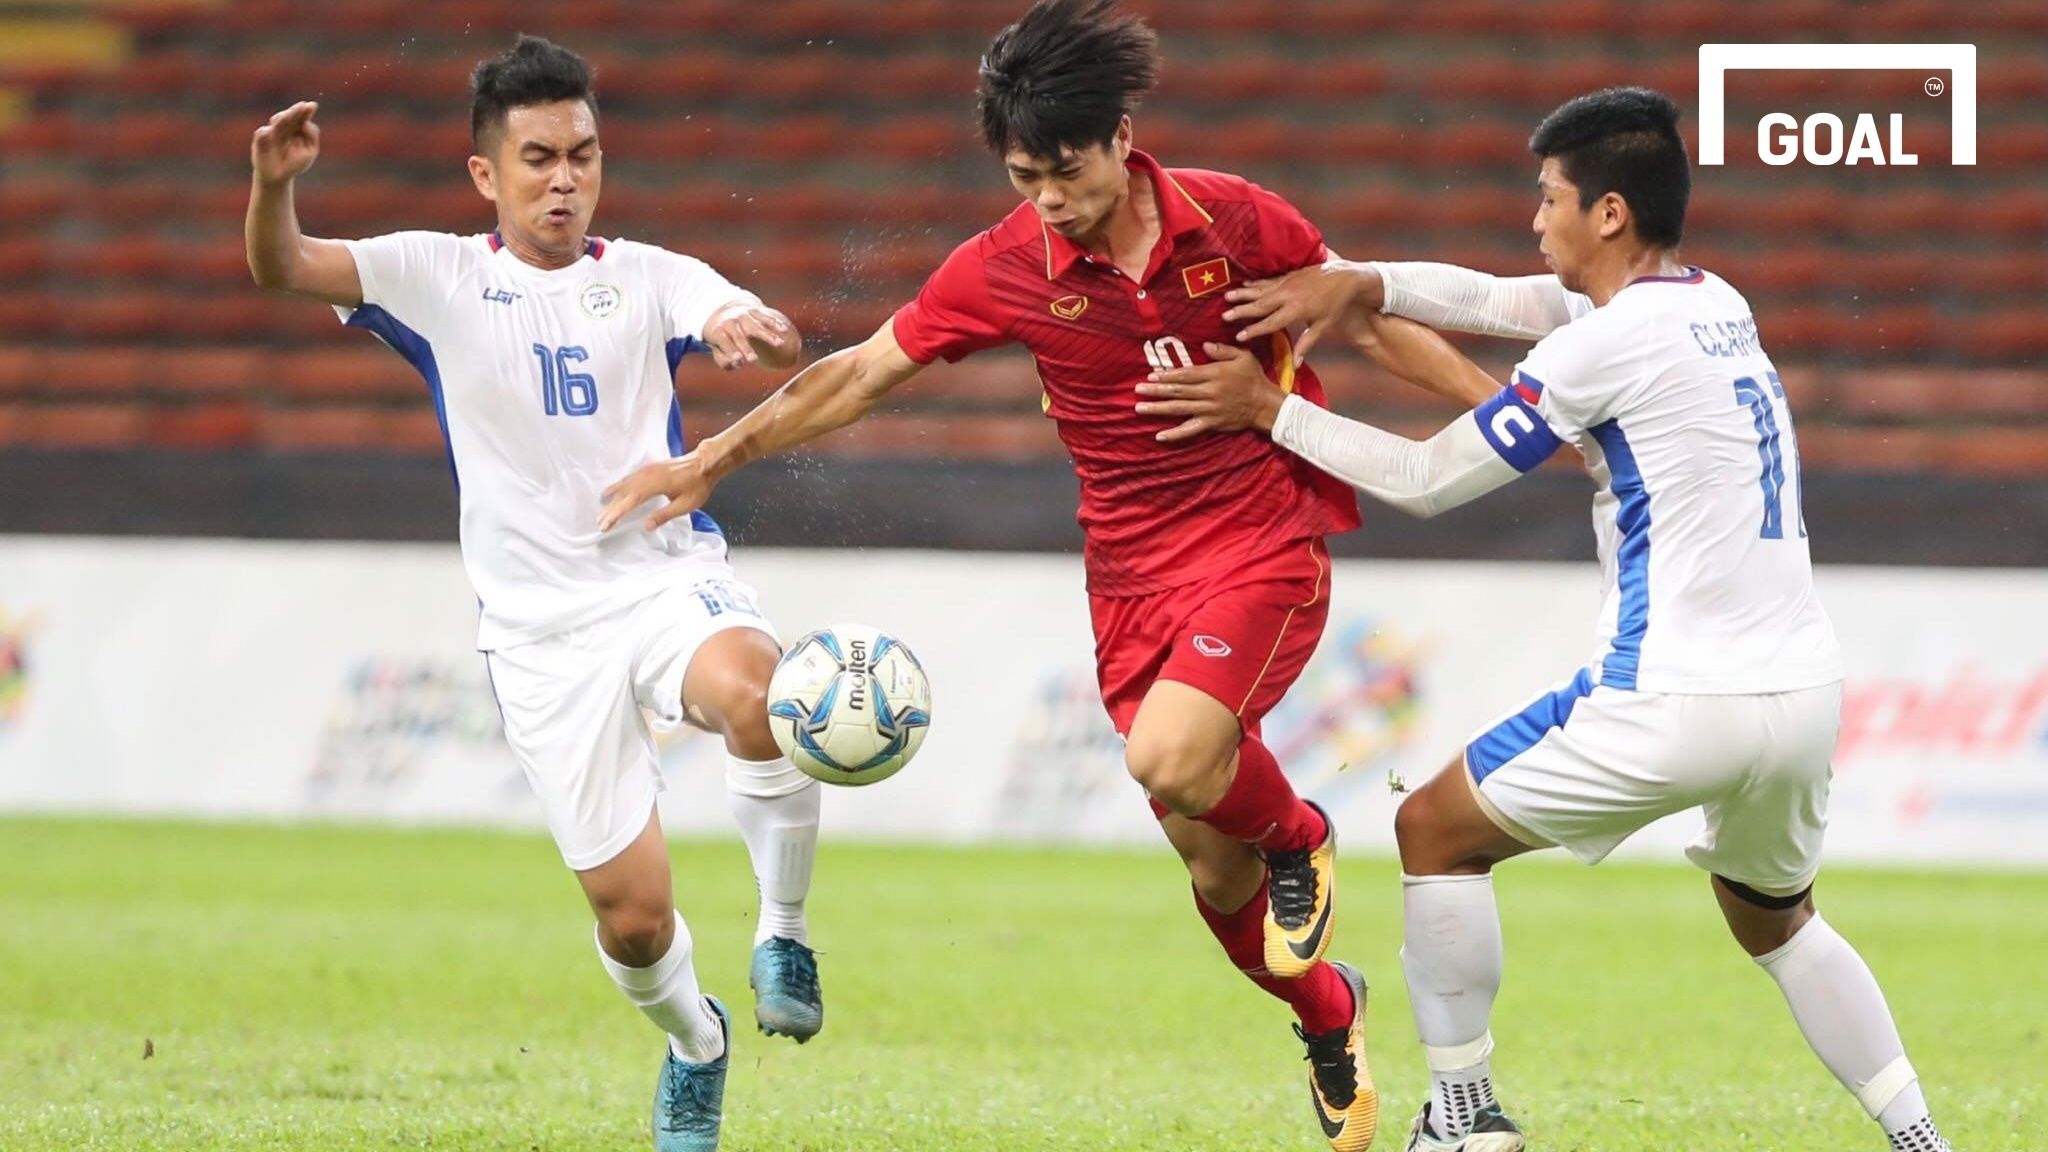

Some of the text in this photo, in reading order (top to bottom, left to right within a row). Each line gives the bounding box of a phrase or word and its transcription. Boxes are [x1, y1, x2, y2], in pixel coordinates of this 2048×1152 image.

[533, 343, 599, 416] 16
[1143, 335, 1194, 373] 10
[1490, 404, 1535, 448] C
[848, 640, 866, 711] molten
